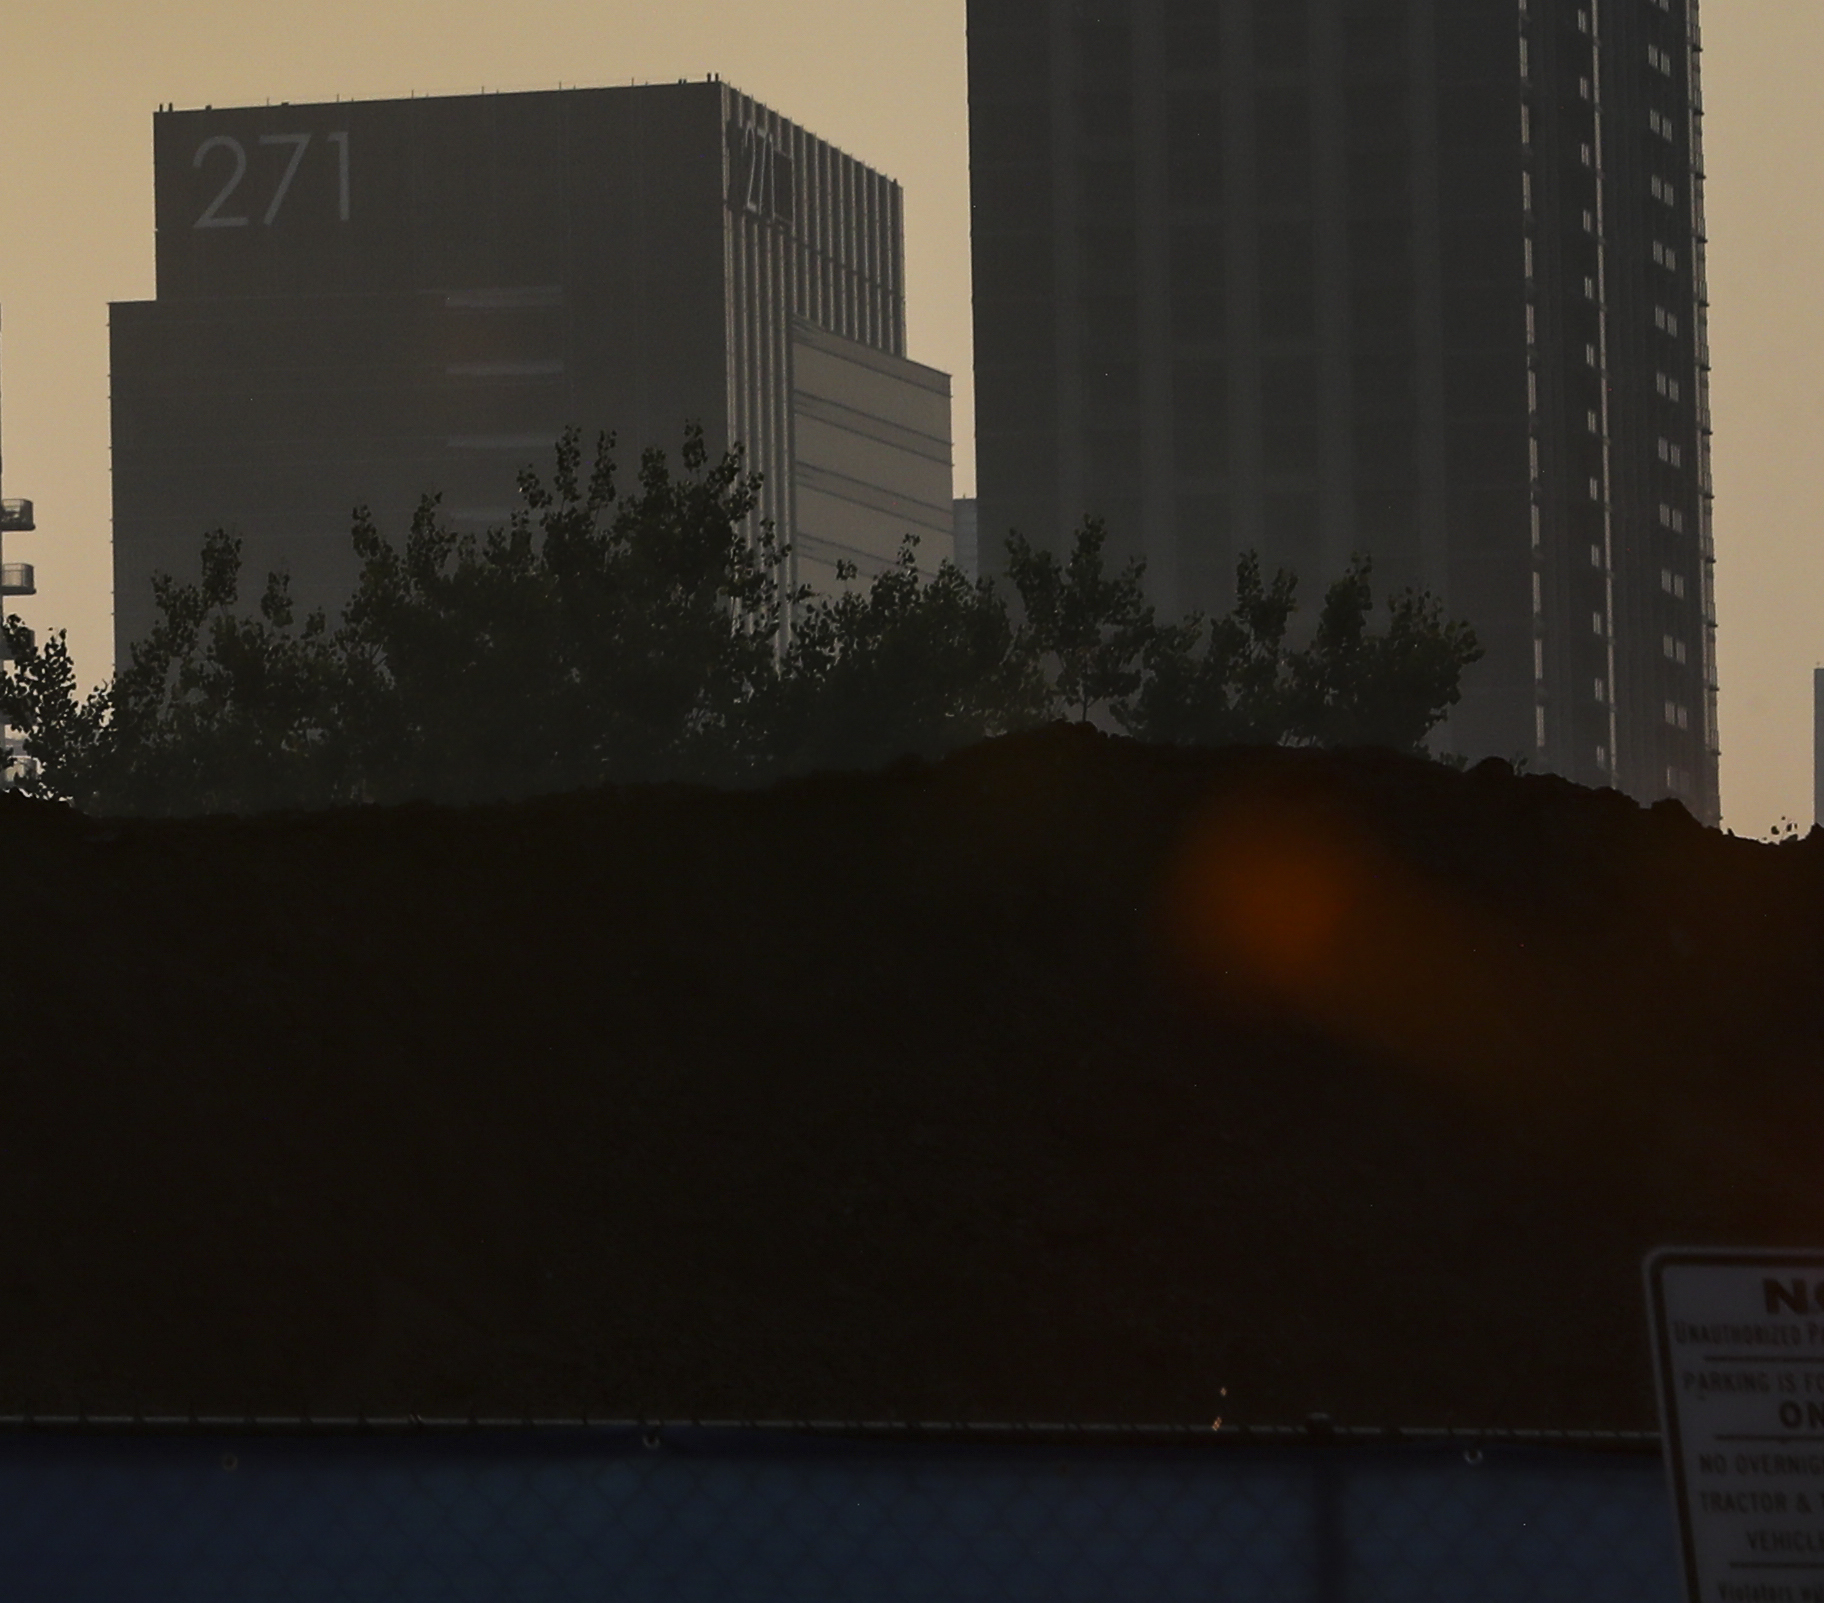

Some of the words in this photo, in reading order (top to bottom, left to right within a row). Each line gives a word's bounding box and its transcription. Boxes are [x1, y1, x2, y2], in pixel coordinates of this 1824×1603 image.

[193, 132, 350, 228] 271
[1763, 1279, 1824, 1315] N
[1807, 1321, 1824, 1345] P
[1683, 1371, 1770, 1392] PARKING
[1777, 1371, 1796, 1393] IS
[1699, 1453, 1727, 1475] NO
[1734, 1453, 1824, 1475] OVERNIG
[1699, 1490, 1787, 1513] TRACTOR
[1795, 1492, 1813, 1513] &
